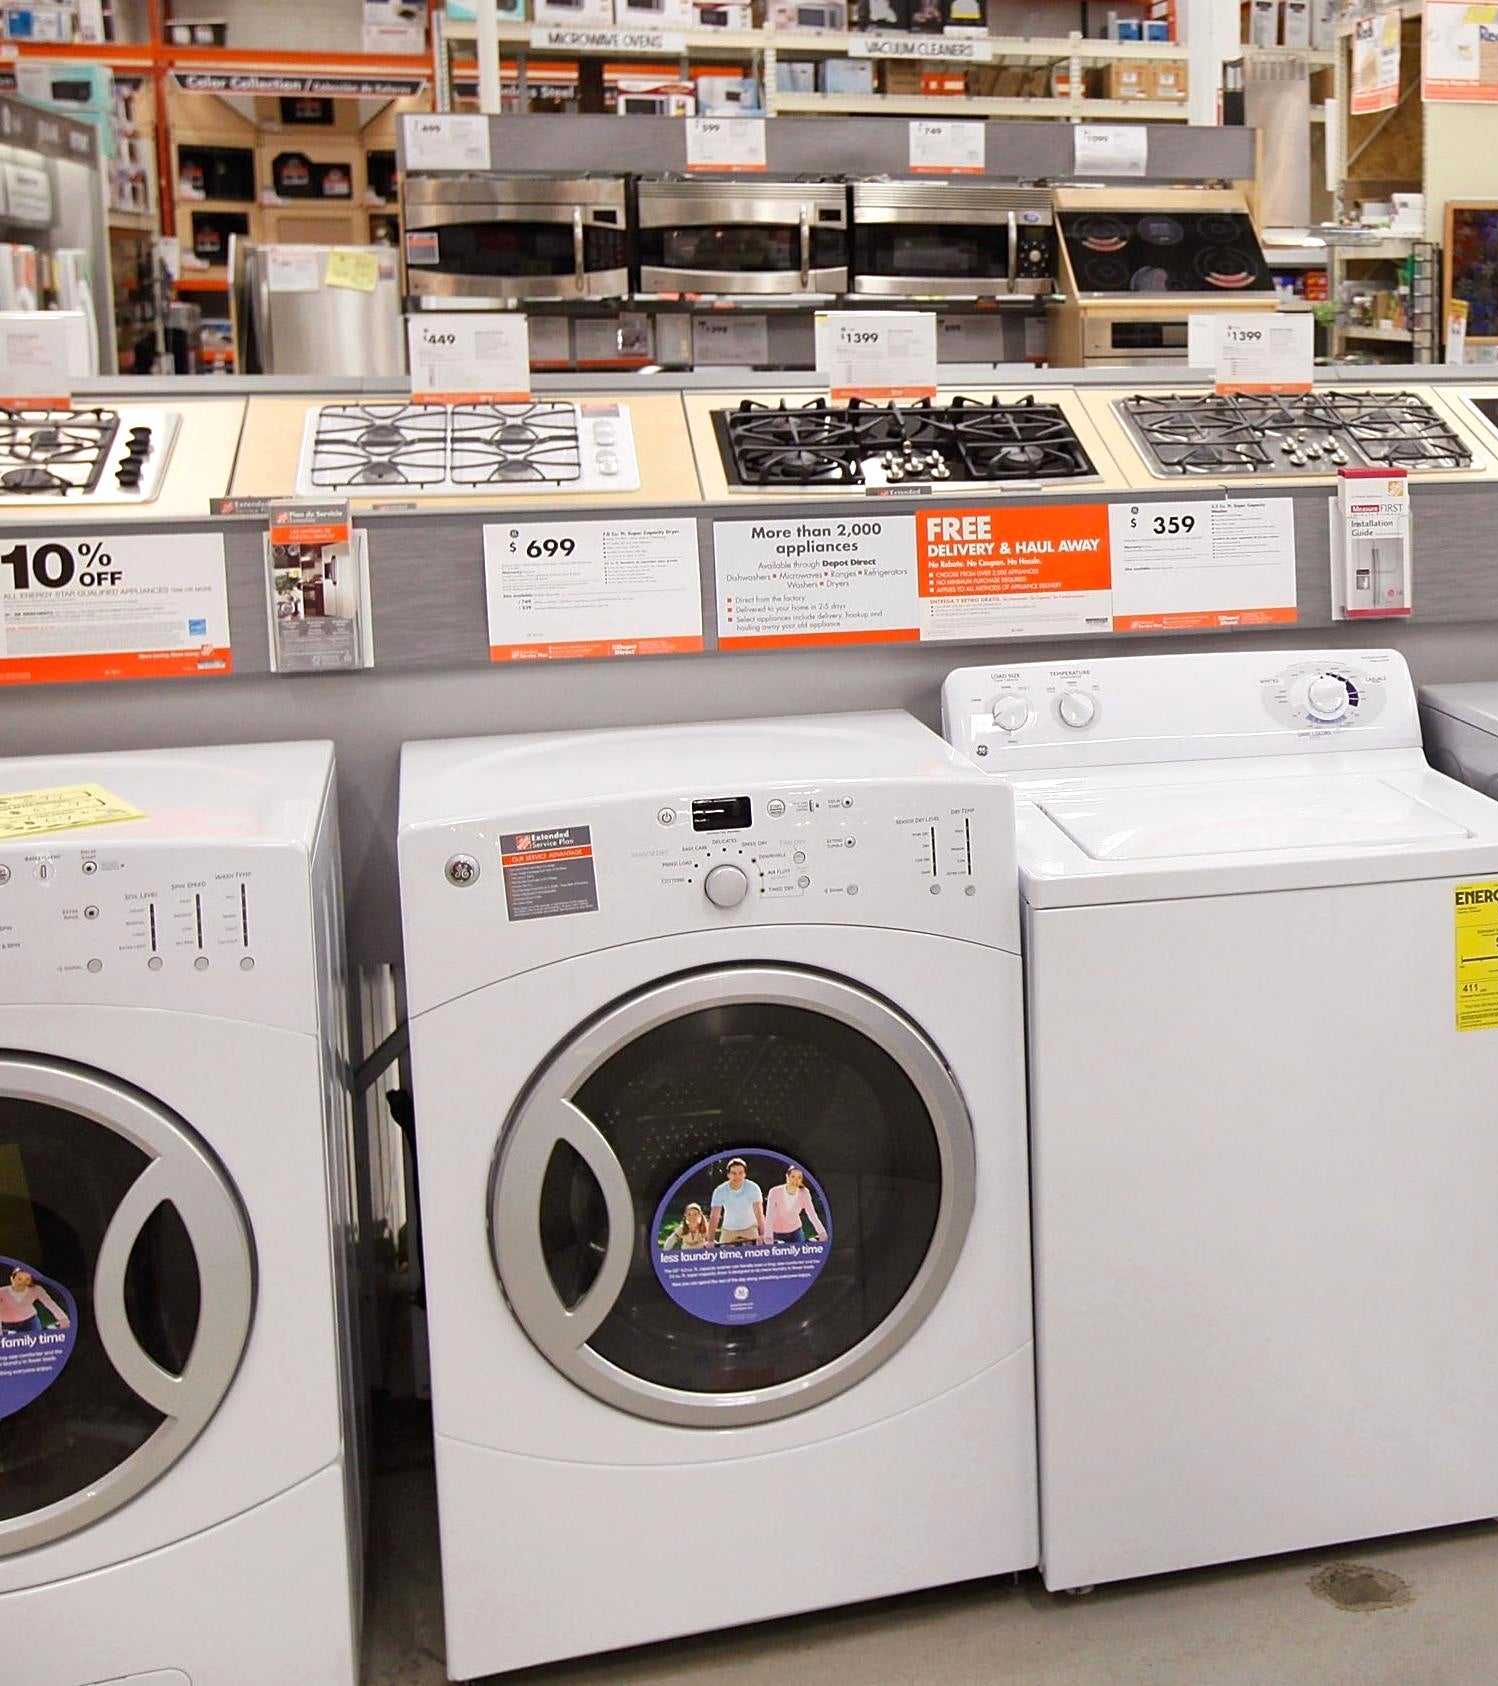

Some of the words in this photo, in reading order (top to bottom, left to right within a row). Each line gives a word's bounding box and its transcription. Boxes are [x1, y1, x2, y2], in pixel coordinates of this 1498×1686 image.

[549, 31, 621, 47] MICROWAVE
[624, 33, 662, 48] OVENS
[865, 41, 916, 55] VACUUM
[917, 43, 974, 58] CLEANERS
[751, 527, 791, 539] More
[797, 526, 831, 537] than
[836, 523, 882, 537] 2,000
[926, 516, 992, 542] FREE
[1130, 518, 1137, 528] $
[1153, 515, 1195, 535] 359
[1351, 520, 1393, 528] Installation
[510, 541, 516, 553] $
[526, 538, 576, 559] 699
[776, 540, 858, 557] appliances
[928, 543, 995, 557] DELIVERY
[999, 542, 1011, 555] &
[1015, 541, 1055, 554] HAUL
[1058, 538, 1100, 552] AWAY
[758, 561, 791, 569] Available
[793, 560, 820, 570] through
[822, 560, 848, 568] Depot
[850, 558, 876, 566] Direct
[79, 571, 123, 587] OFF
[726, 574, 771, 582] Dishwashers
[826, 580, 849, 589] Dryers
[532, 830, 569, 841] Extended
[532, 840, 557, 848] Service
[1463, 984, 1479, 992] 411
[660, 1253, 679, 1263] less
[681, 1251, 717, 1263] laundry
[719, 1249, 743, 1259] time,
[745, 1249, 770, 1258] more
[771, 1246, 800, 1257] family
[802, 1245, 823, 1254] time
[1, 1335, 36, 1348] family
[39, 1333, 65, 1344] time
